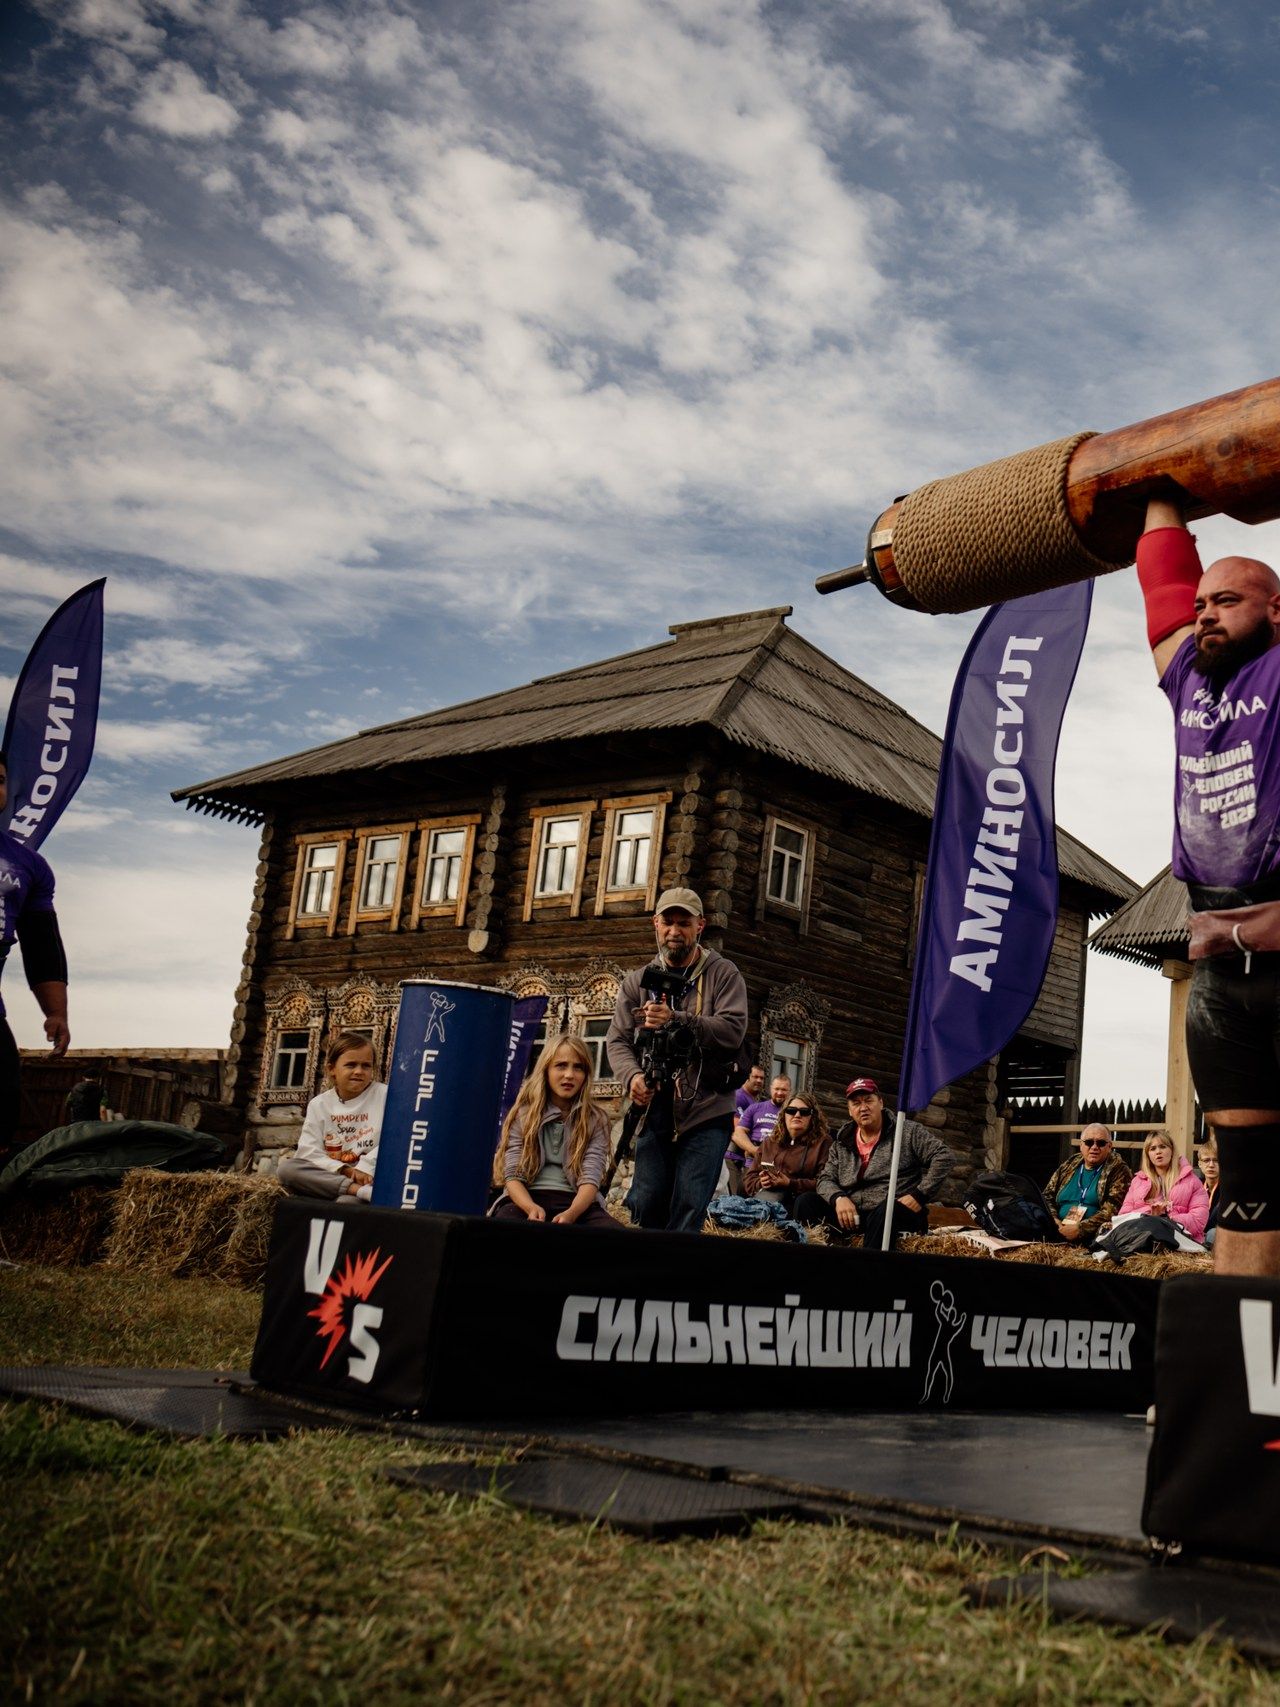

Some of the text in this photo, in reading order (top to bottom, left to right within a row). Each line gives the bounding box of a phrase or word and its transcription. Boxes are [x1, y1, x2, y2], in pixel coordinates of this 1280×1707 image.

[9, 664, 79, 844] НОСИЛ
[948, 635, 1043, 993] АМИНОСИЛ
[330, 1113, 368, 1123] PUMPKIN
[556, 1293, 1137, 1371] СИЛЬНЕЙШИЙ ЧЕЛОВЕК
